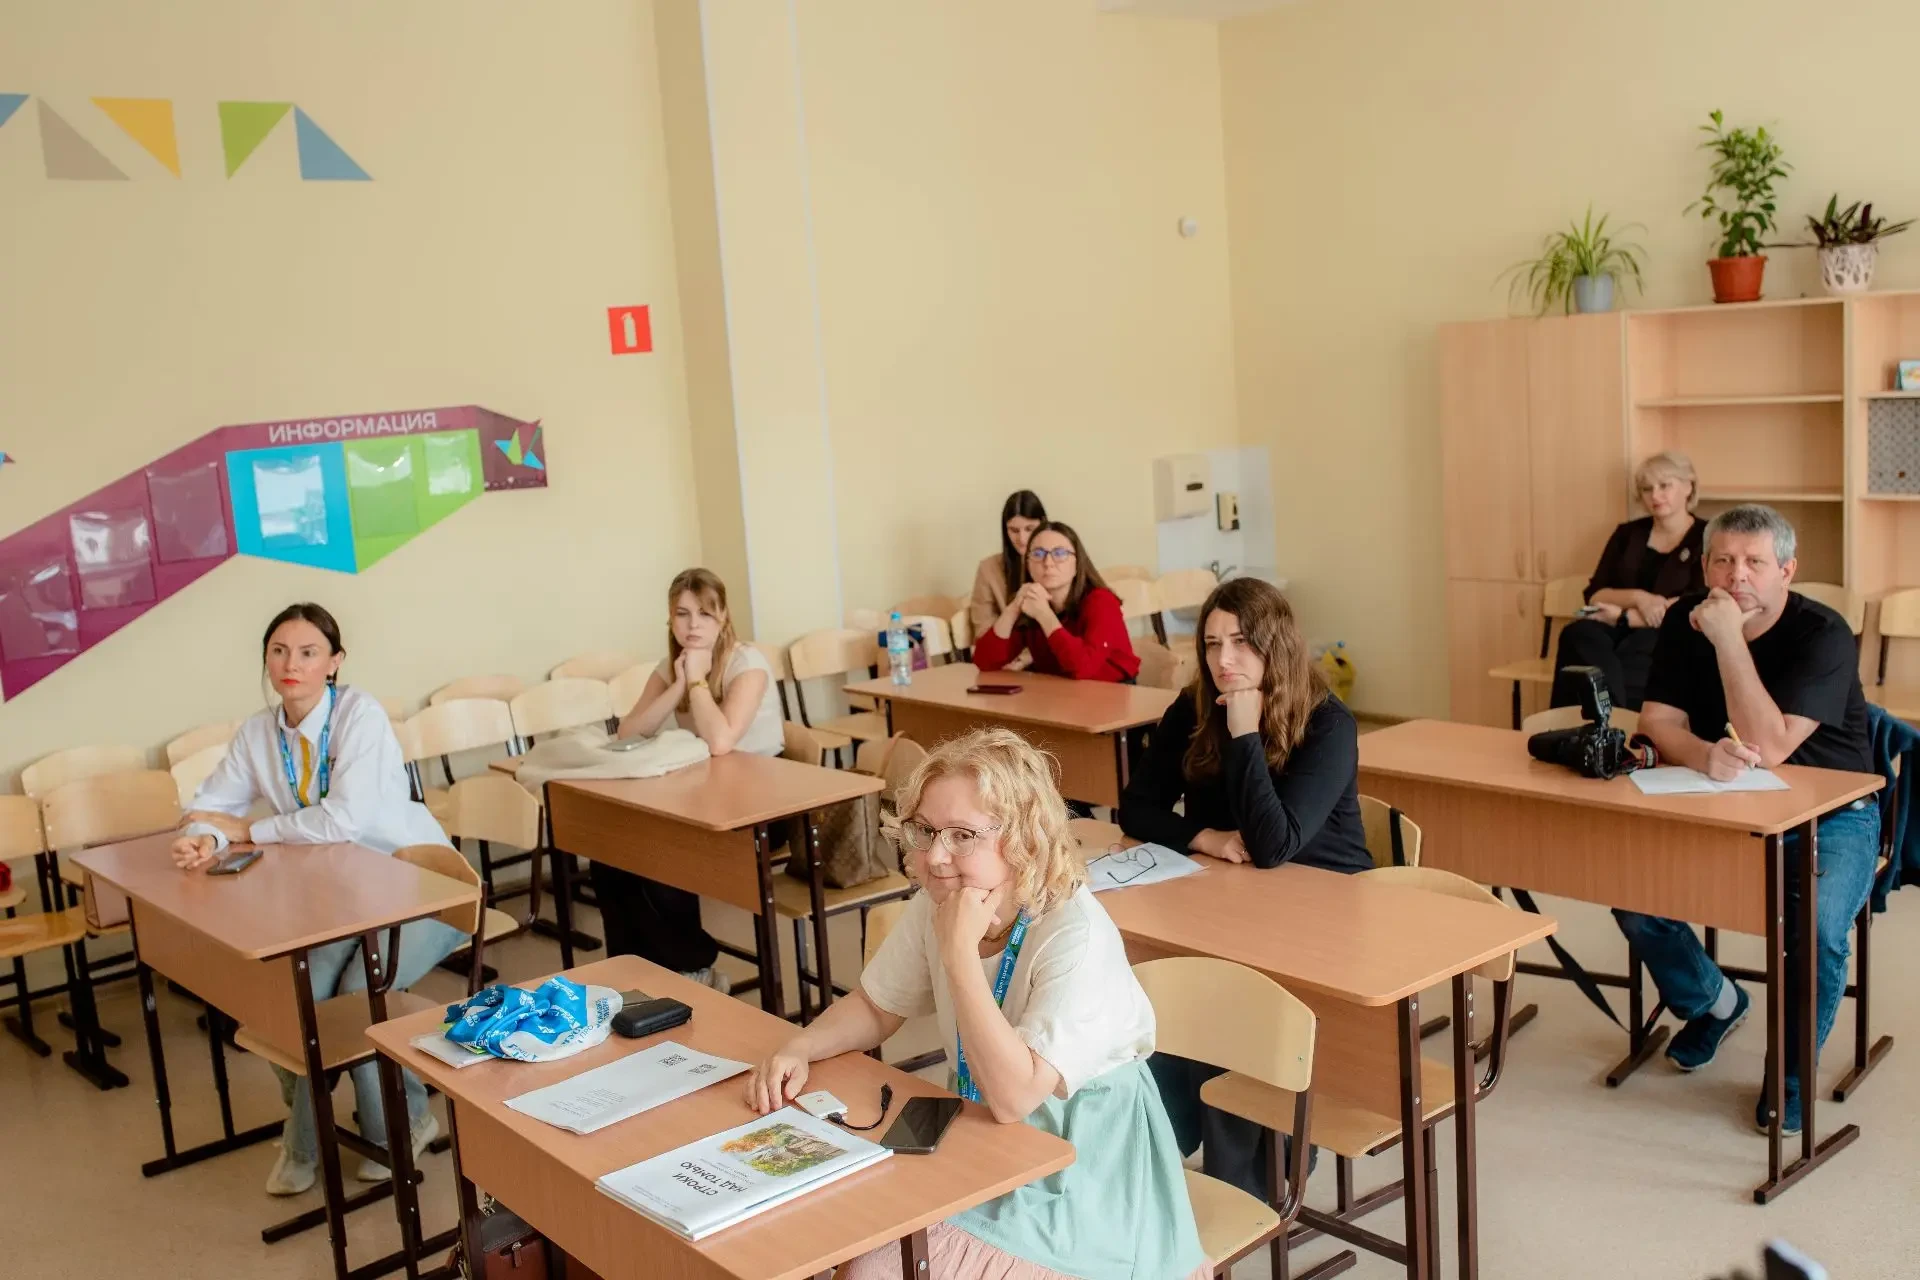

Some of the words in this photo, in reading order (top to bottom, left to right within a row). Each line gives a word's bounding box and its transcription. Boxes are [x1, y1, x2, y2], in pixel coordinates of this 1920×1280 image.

[268, 412, 437, 443] ИНФОРМАЦИЯ
[672, 1172, 718, 1196] СТРОКИ
[680, 1161, 721, 1184] ТОМЬЮ
[719, 1179, 748, 1193] НАД
